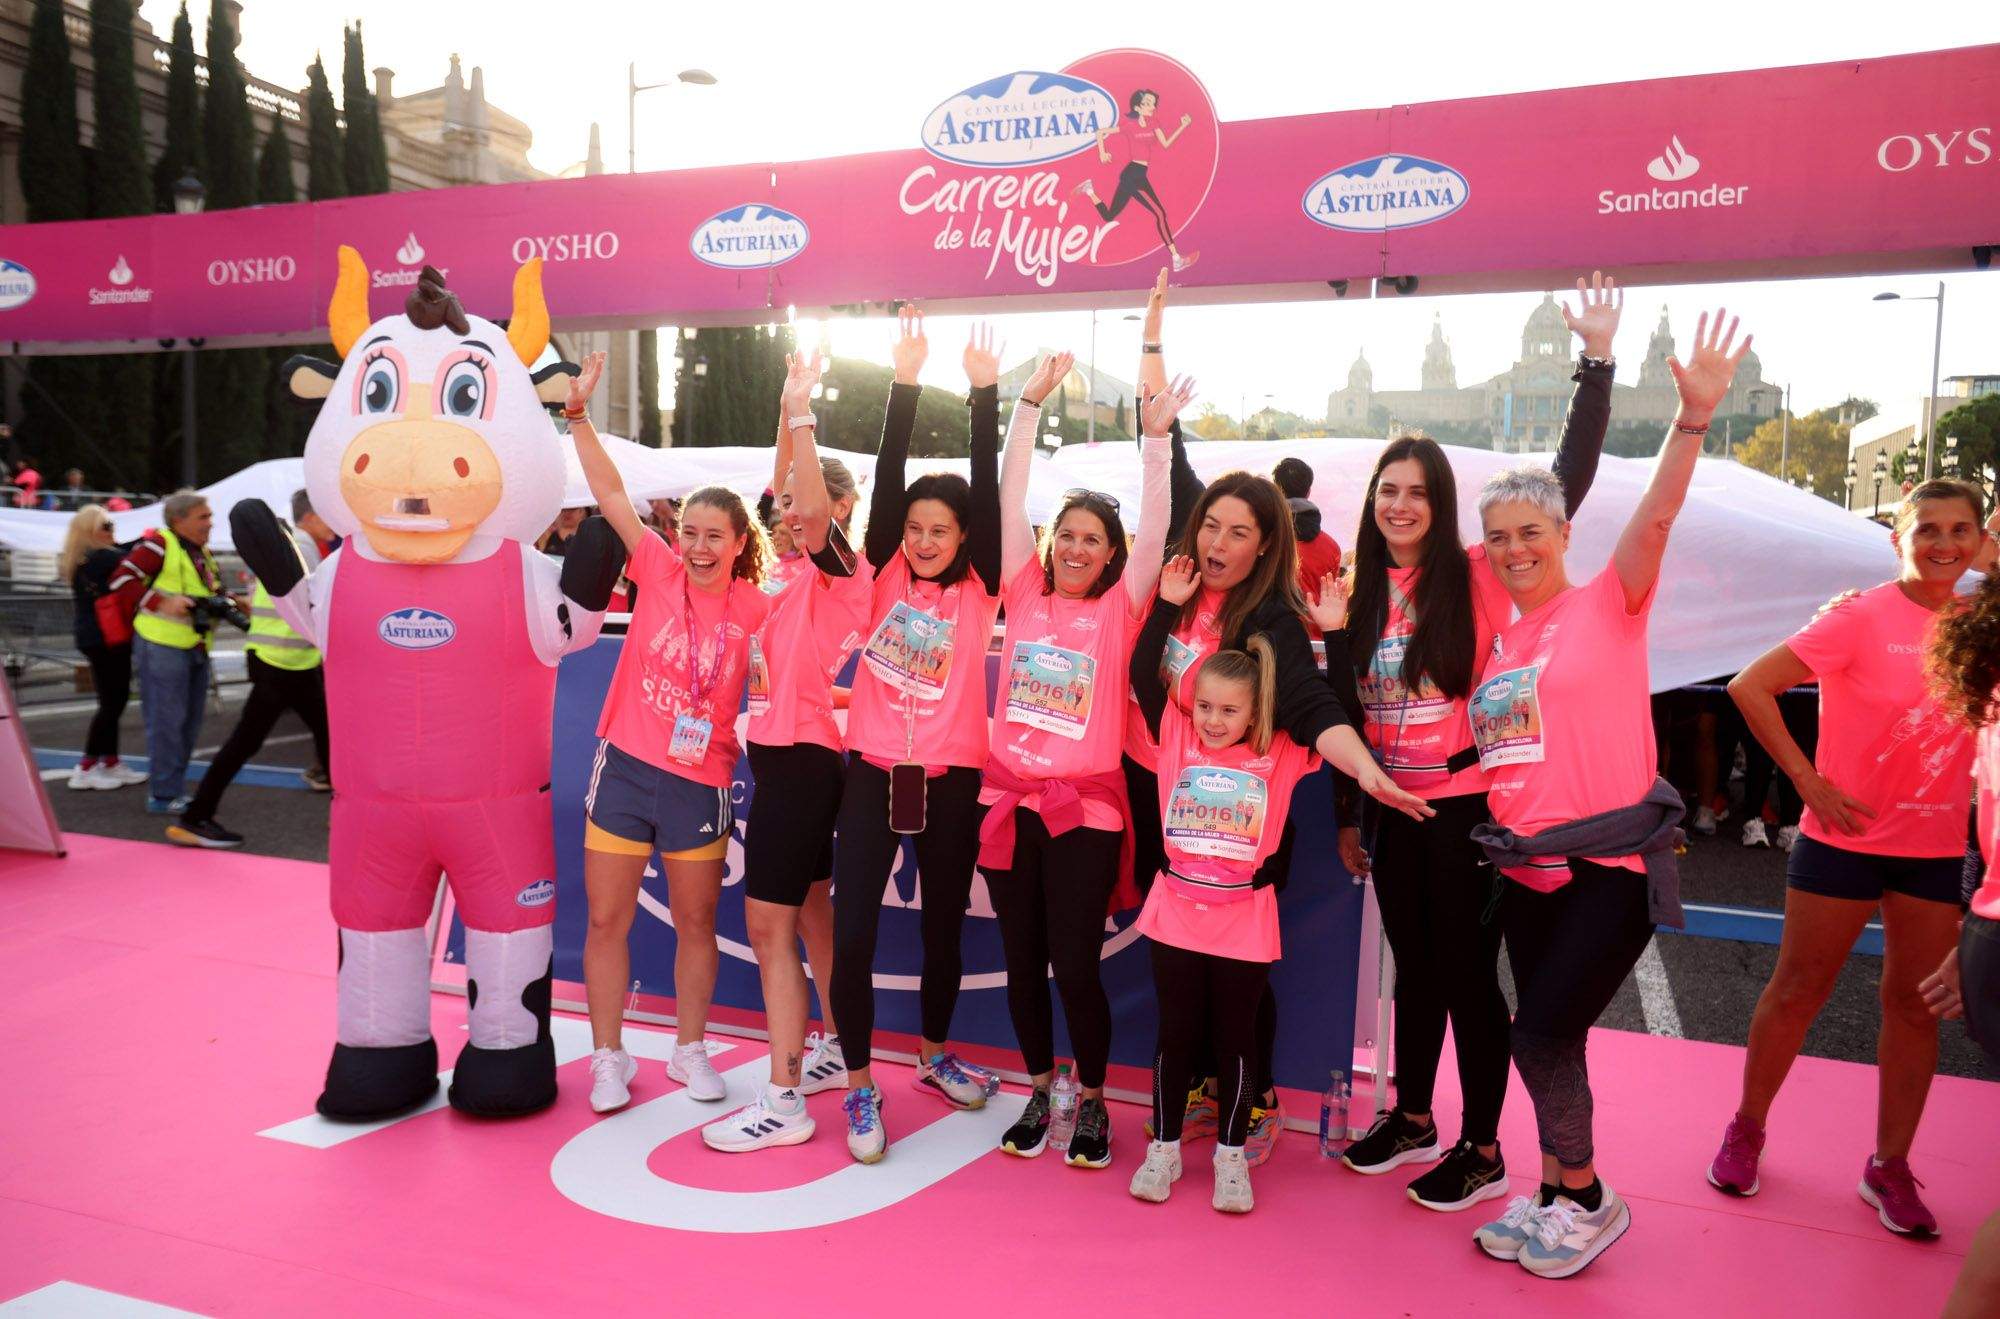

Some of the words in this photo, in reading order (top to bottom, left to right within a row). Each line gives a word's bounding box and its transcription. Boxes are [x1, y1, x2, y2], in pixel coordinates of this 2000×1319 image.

[964, 101, 1026, 117] CENTRAL
[1032, 96, 1097, 112] LECHERA
[933, 110, 1101, 147] ASTURIANA
[1877, 126, 2000, 173] OYS
[899, 164, 1061, 216] Carrera
[1315, 186, 1456, 215] ASTURIANA
[1598, 182, 1750, 215] Santander
[511, 229, 620, 264] OYSHO
[699, 230, 800, 254] ASTURIANA
[934, 215, 965, 251] de
[970, 212, 993, 249] la
[984, 199, 1120, 288] Mujer
[207, 254, 297, 286] OYSHO
[372, 267, 450, 288] Santanr
[88, 285, 153, 305] Santander
[383, 622, 450, 639] ASTURIANA
[660, 678, 717, 714] DORAL
[1029, 680, 1065, 700] 016
[1195, 804, 1233, 822] 016
[1203, 823, 1217, 831] 549
